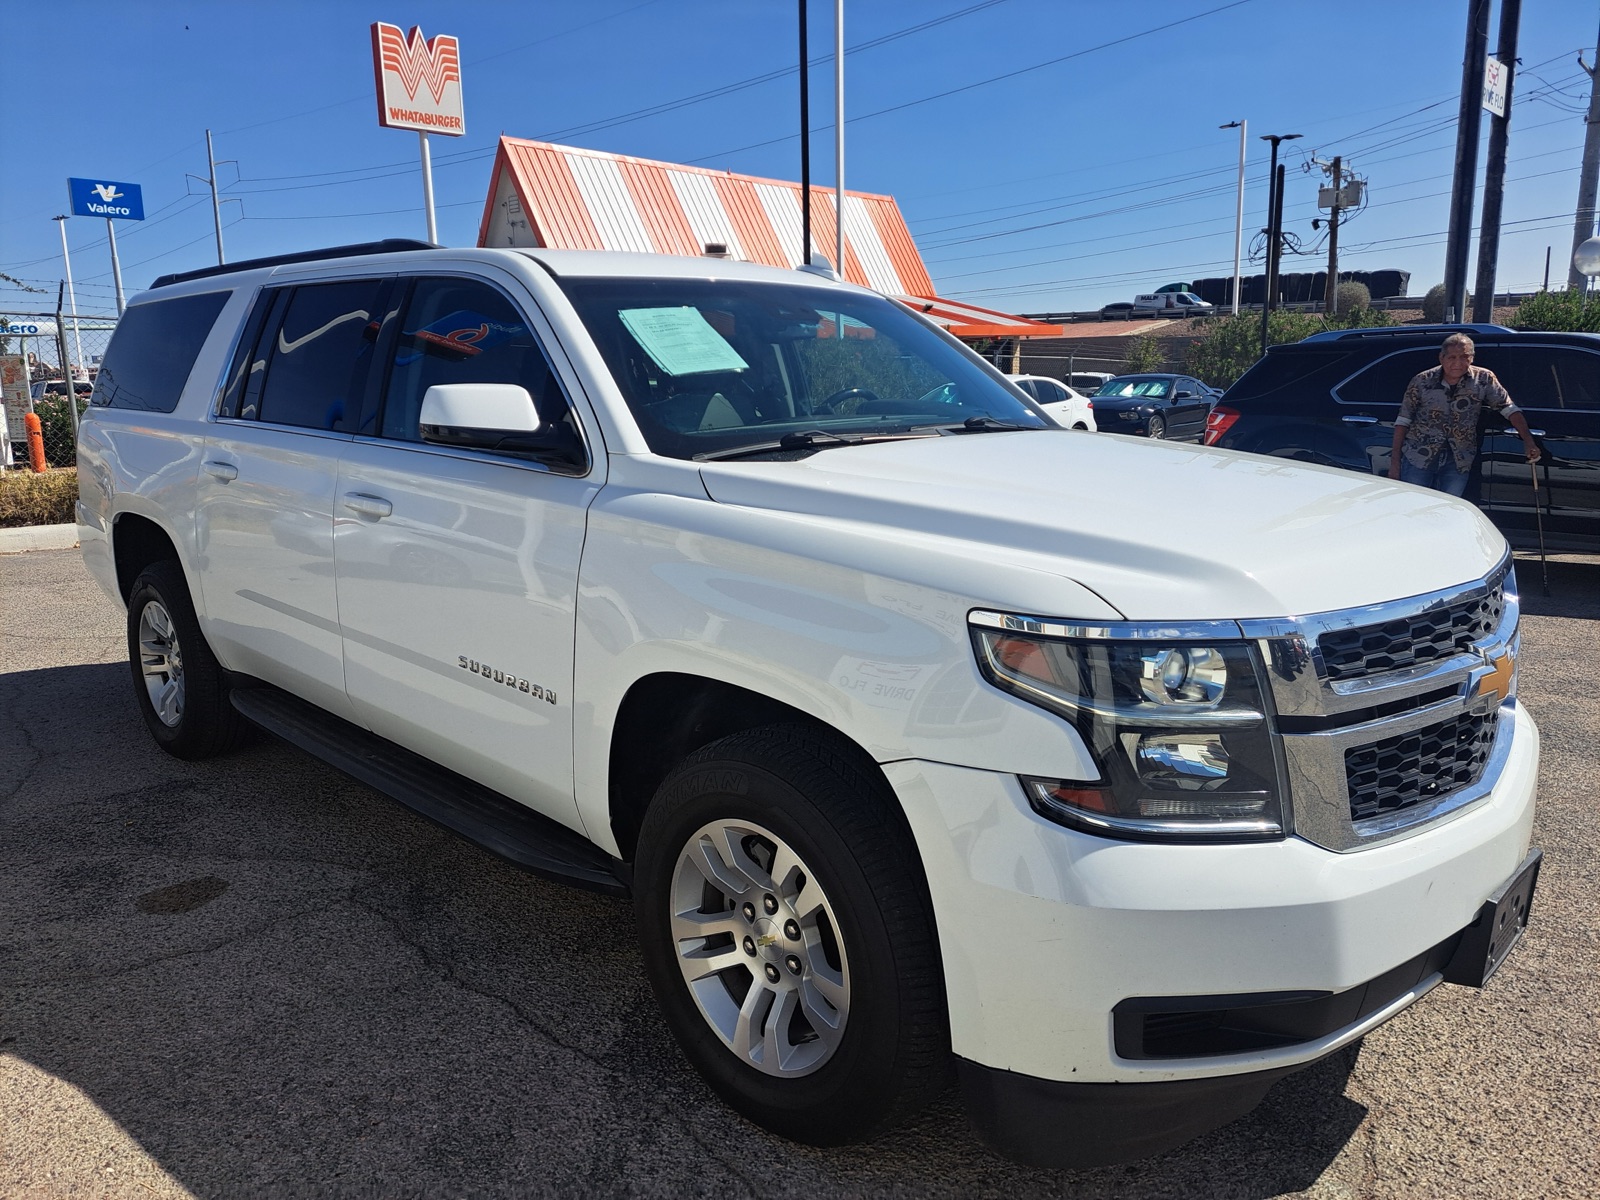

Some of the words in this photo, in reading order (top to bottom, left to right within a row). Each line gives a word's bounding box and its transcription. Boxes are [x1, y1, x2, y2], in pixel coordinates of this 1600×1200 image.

[389, 107, 461, 128] WHATABURGER
[87, 202, 130, 215] Valero
[458, 655, 556, 705] SUBURBAN
